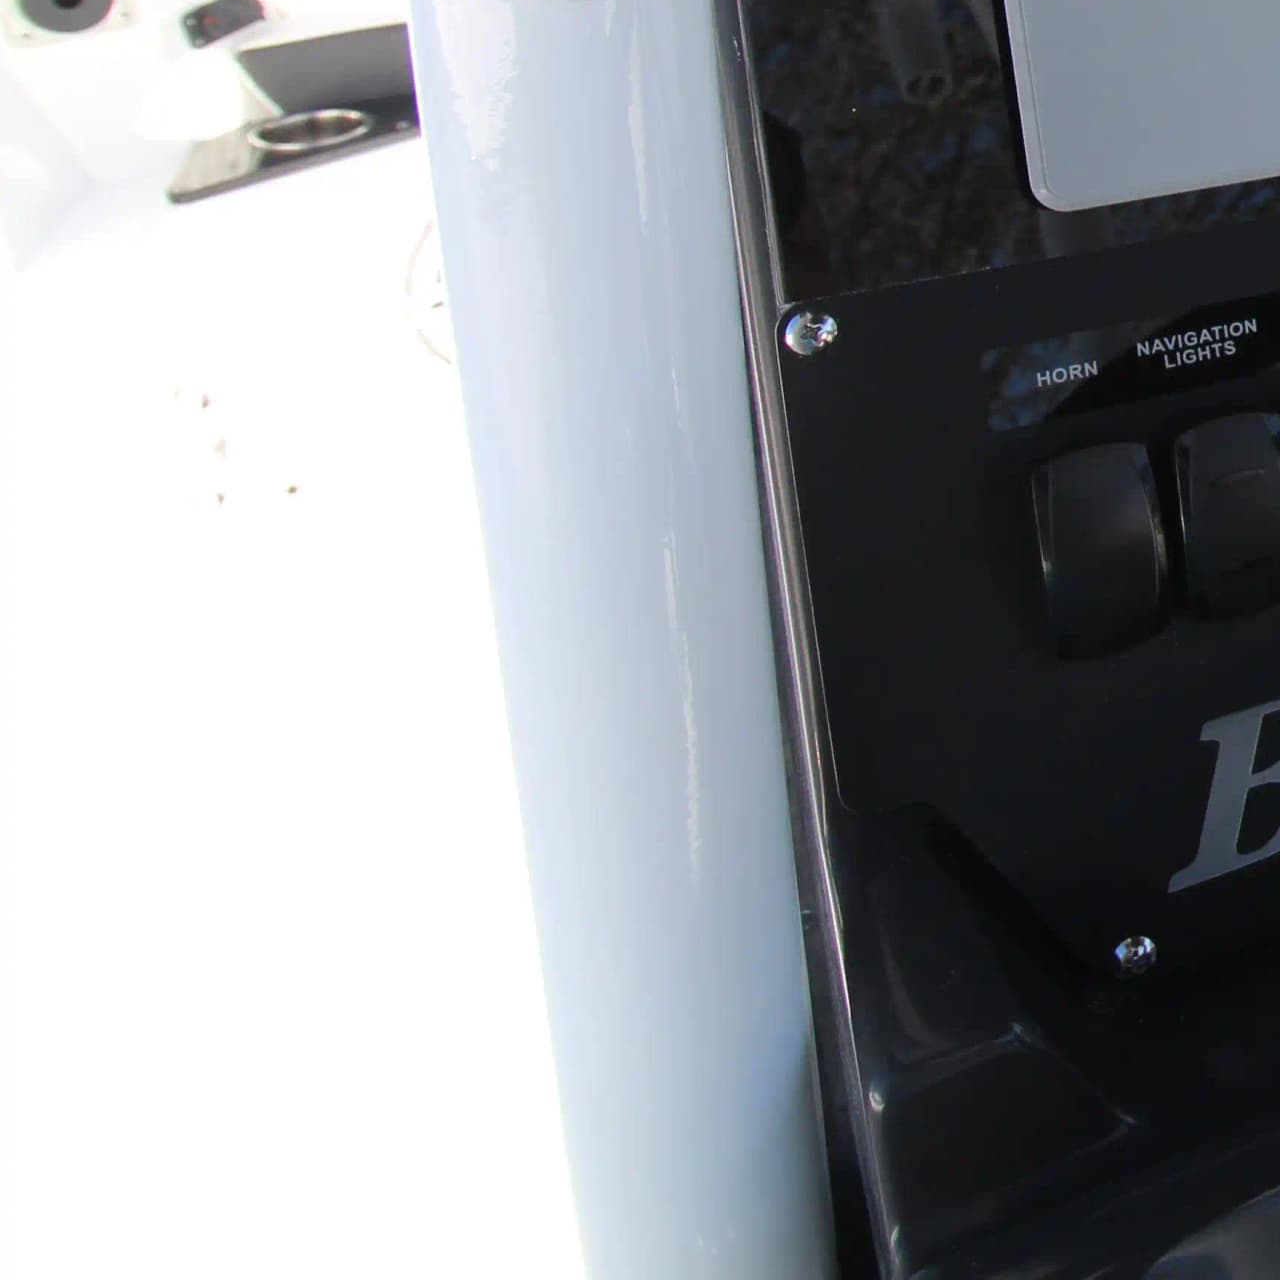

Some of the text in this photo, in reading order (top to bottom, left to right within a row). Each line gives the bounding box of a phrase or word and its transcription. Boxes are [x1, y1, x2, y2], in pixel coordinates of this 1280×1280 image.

[1136, 318, 1258, 357] NAVIGATION
[1164, 339, 1237, 369] LIGHTS
[1036, 360, 1099, 388] HORN
